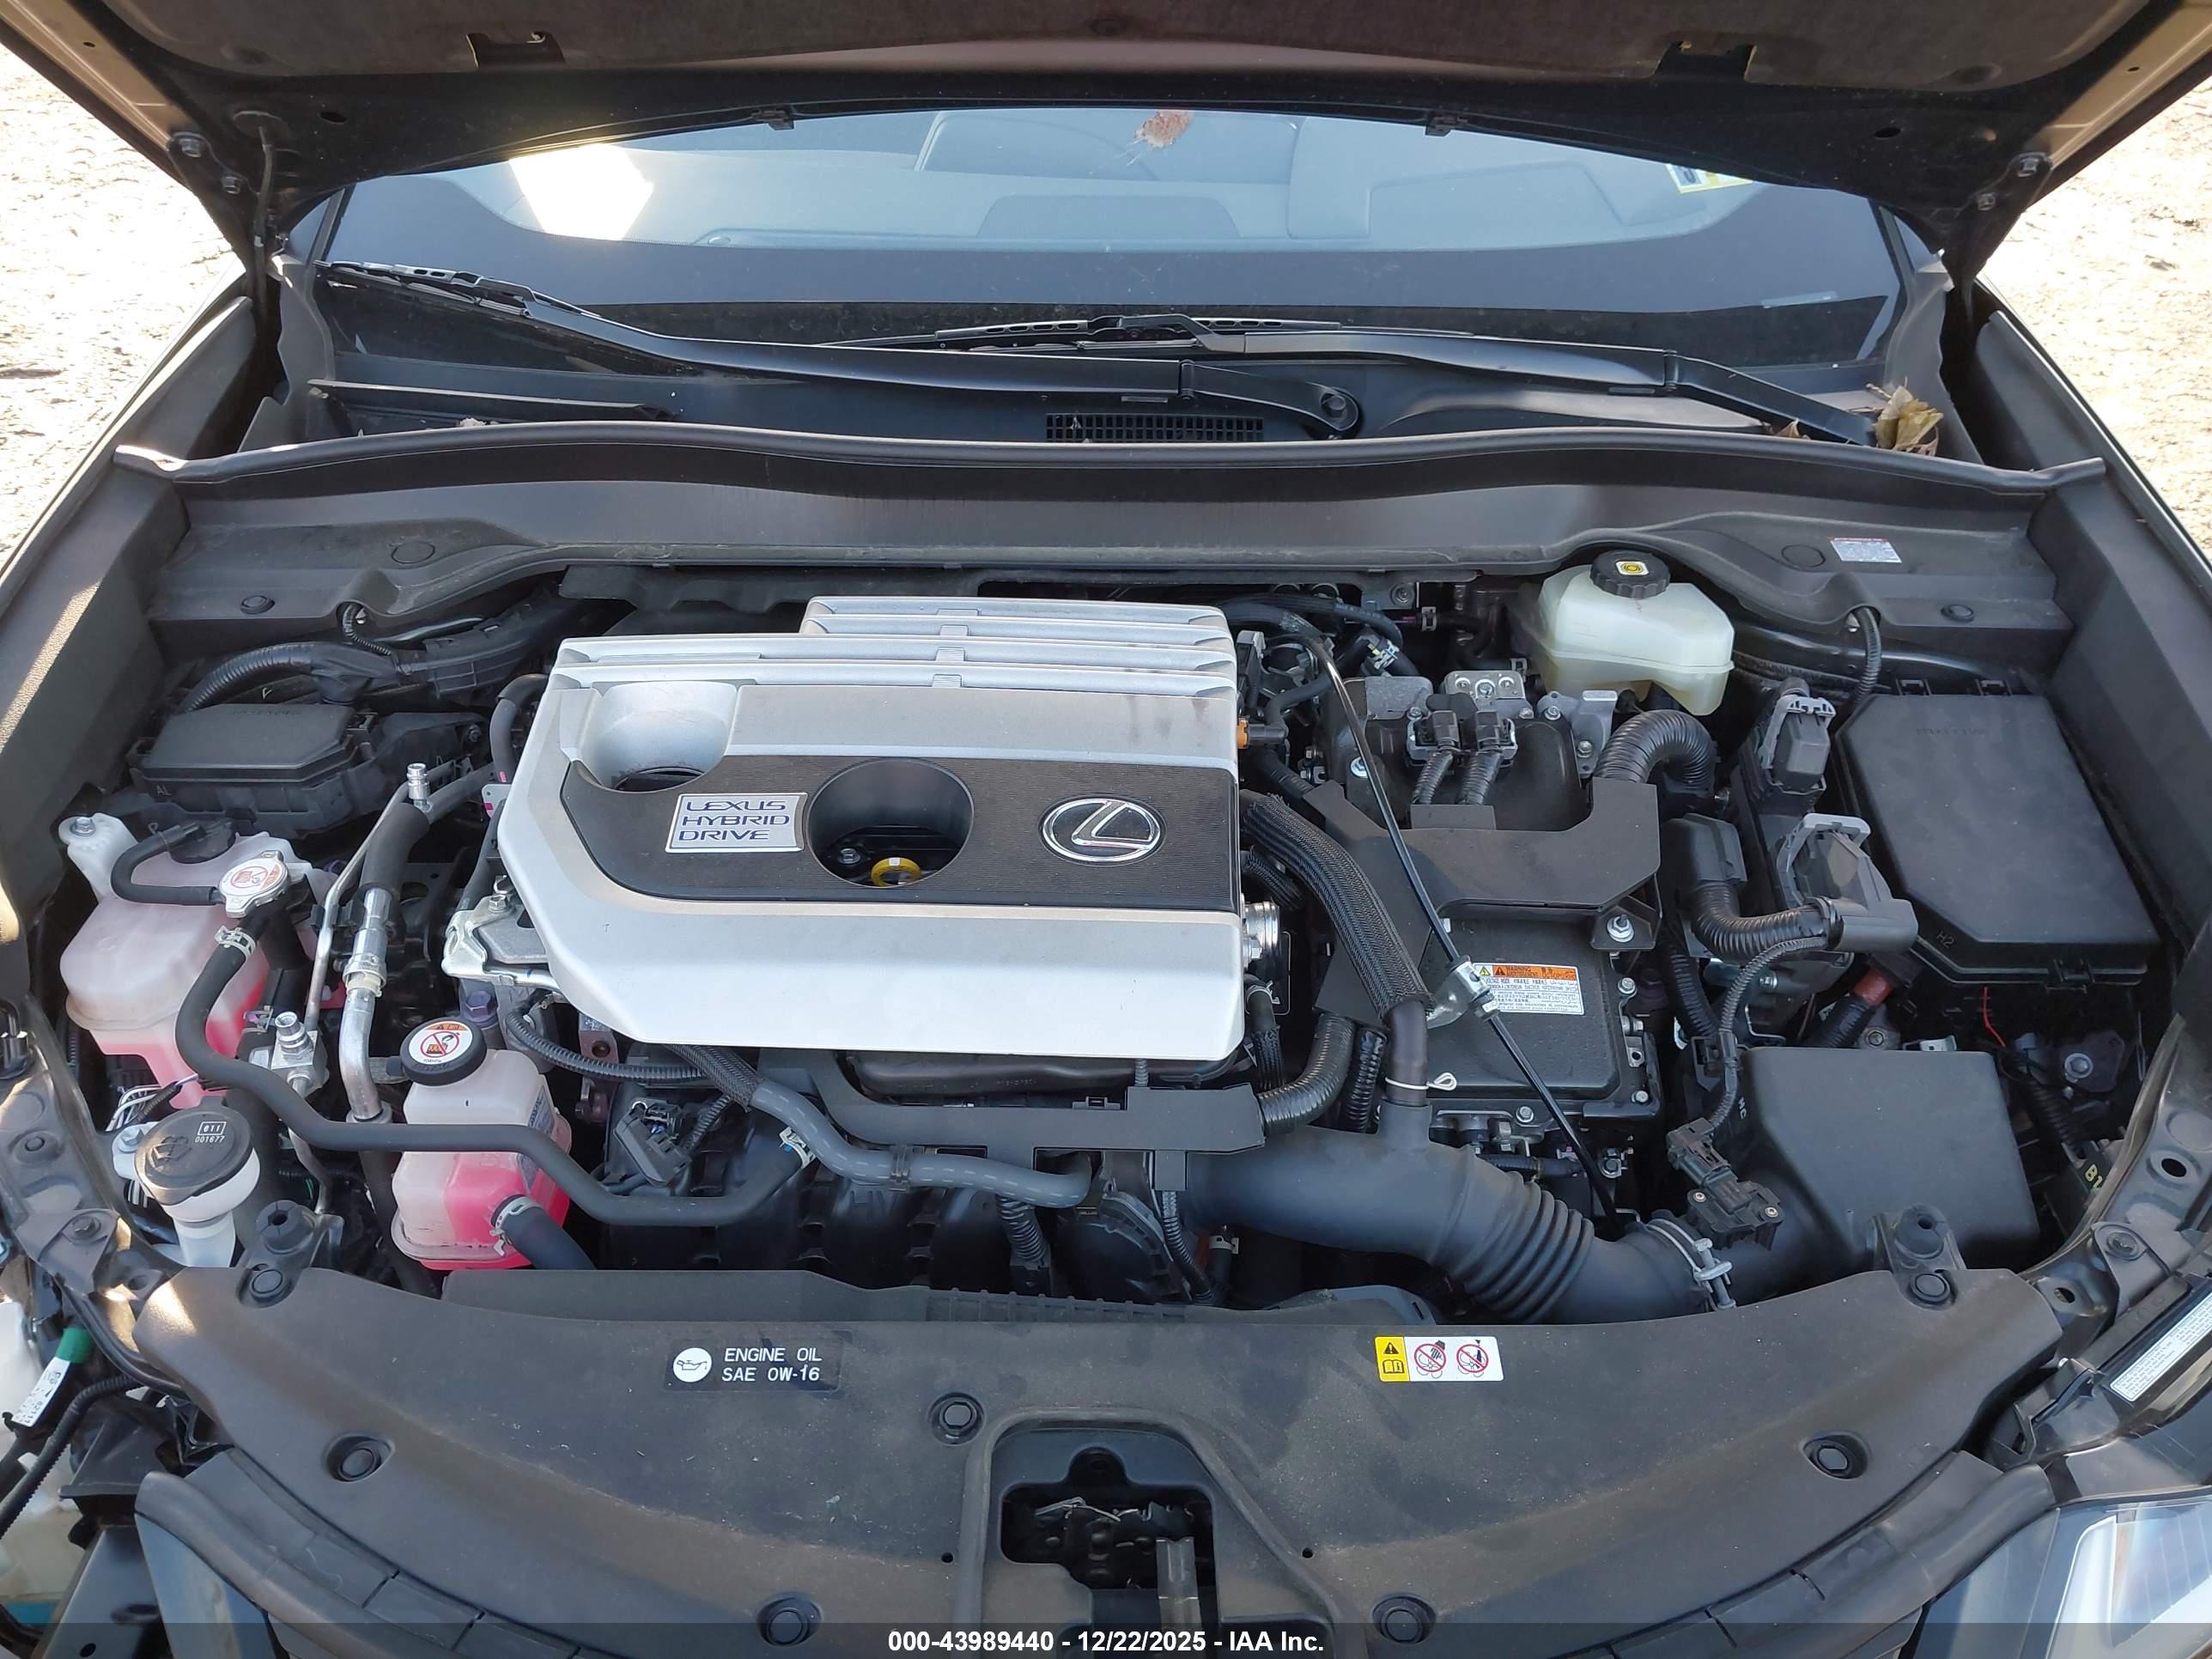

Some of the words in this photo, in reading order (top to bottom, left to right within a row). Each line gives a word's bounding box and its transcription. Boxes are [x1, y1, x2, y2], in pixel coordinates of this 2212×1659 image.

[686, 800, 787, 811] LEXUS
[682, 815, 790, 826] HYBRID
[678, 830, 770, 841] DRIVE
[724, 1347, 786, 1362] ENGINE
[796, 1347, 823, 1362] OIL
[721, 1367, 757, 1382] SAE
[767, 1367, 821, 1382] 0W-16
